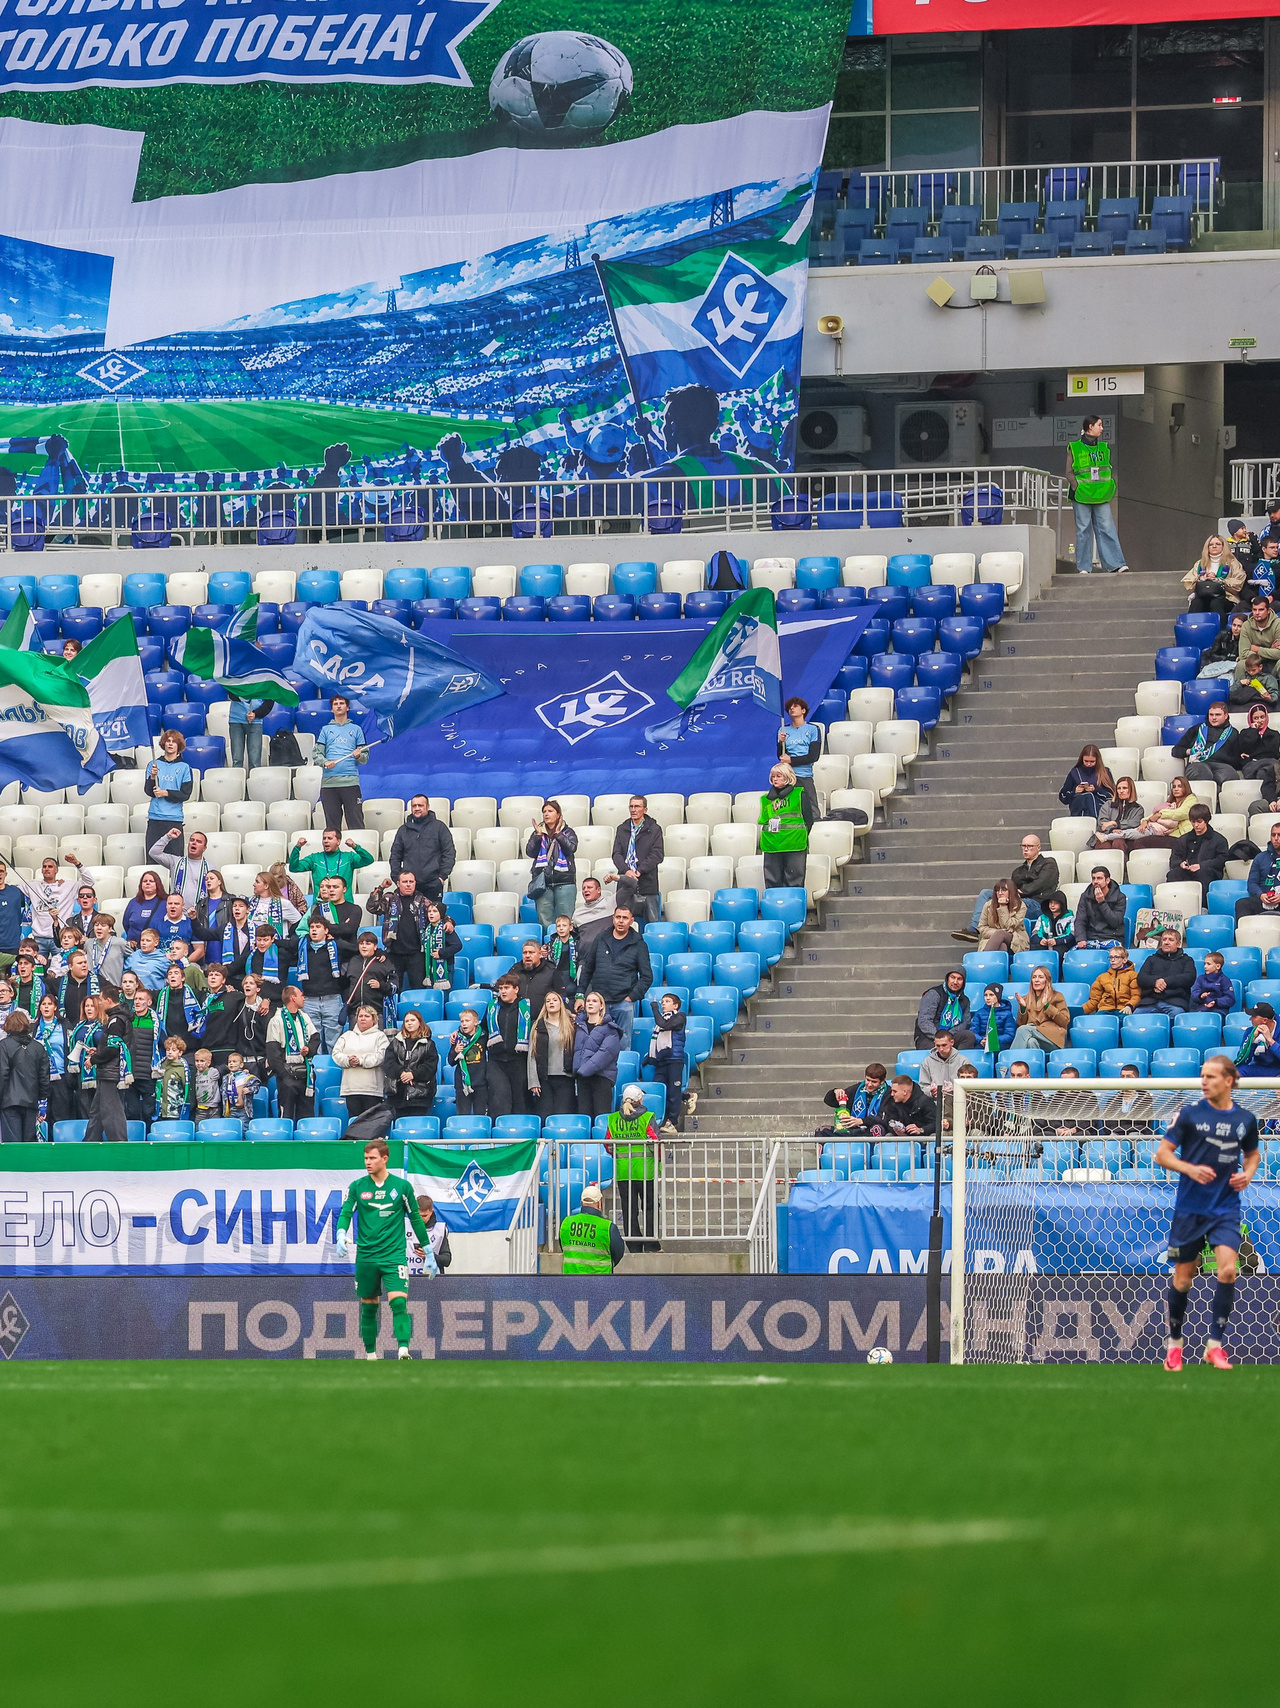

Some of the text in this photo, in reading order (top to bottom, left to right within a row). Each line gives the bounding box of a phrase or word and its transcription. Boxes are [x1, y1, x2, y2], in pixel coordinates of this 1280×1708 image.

[194, 12, 437, 66] ПОБЕДА!
[1076, 377, 1117, 392] D 115
[1025, 612, 1036, 620] 20
[1007, 646, 1016, 654] 19
[964, 715, 973, 723] 17
[899, 818, 908, 826] 14
[877, 852, 886, 860] 13
[854, 886, 862, 894] 12
[832, 919, 840, 927] 11
[570, 1221, 596, 1239] 9875
[568, 1239, 596, 1248] STEWARD
[188, 1300, 1156, 1362] ПОДДЕРЖИ КОМАНДУ
